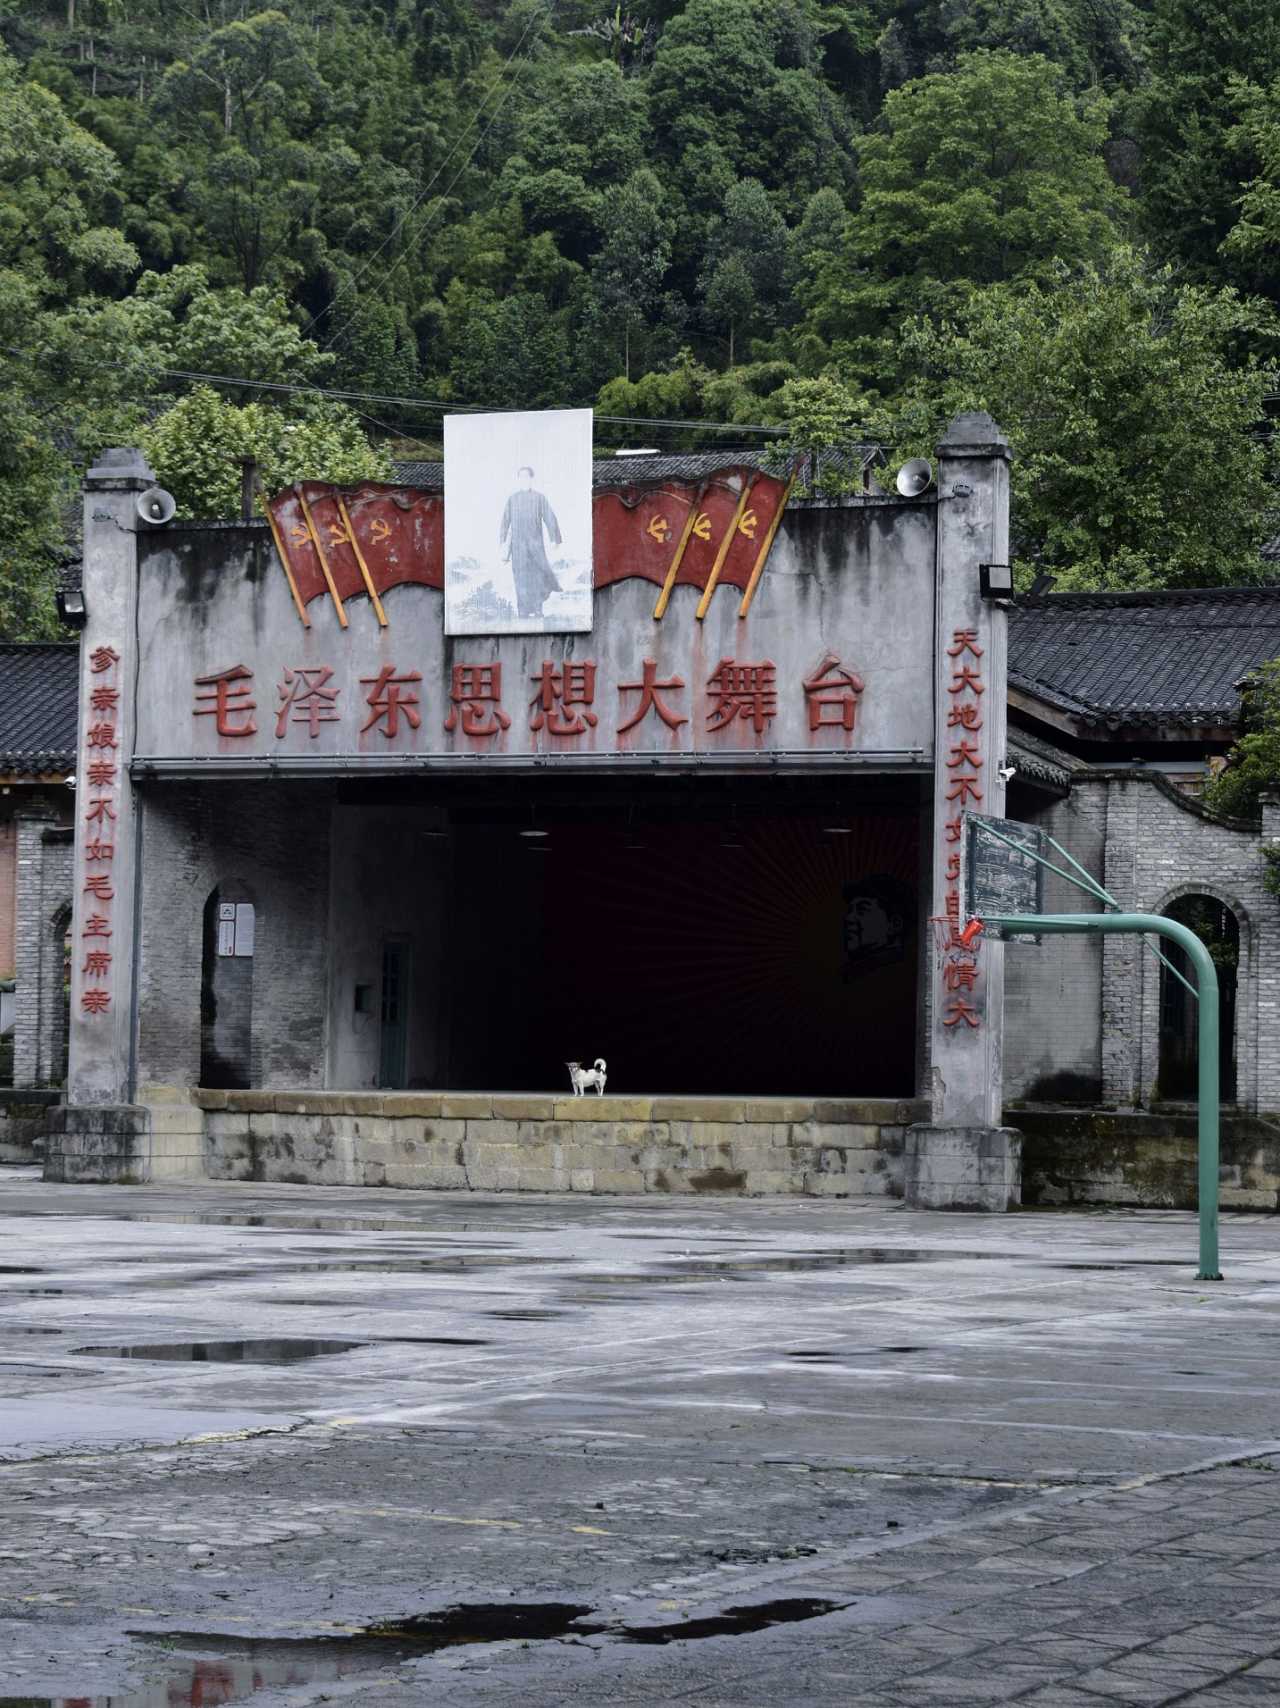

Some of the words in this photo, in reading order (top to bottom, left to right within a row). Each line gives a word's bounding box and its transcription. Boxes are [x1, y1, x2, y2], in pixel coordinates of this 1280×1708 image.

[192, 655, 866, 738] 毛泽东思想大舞台
